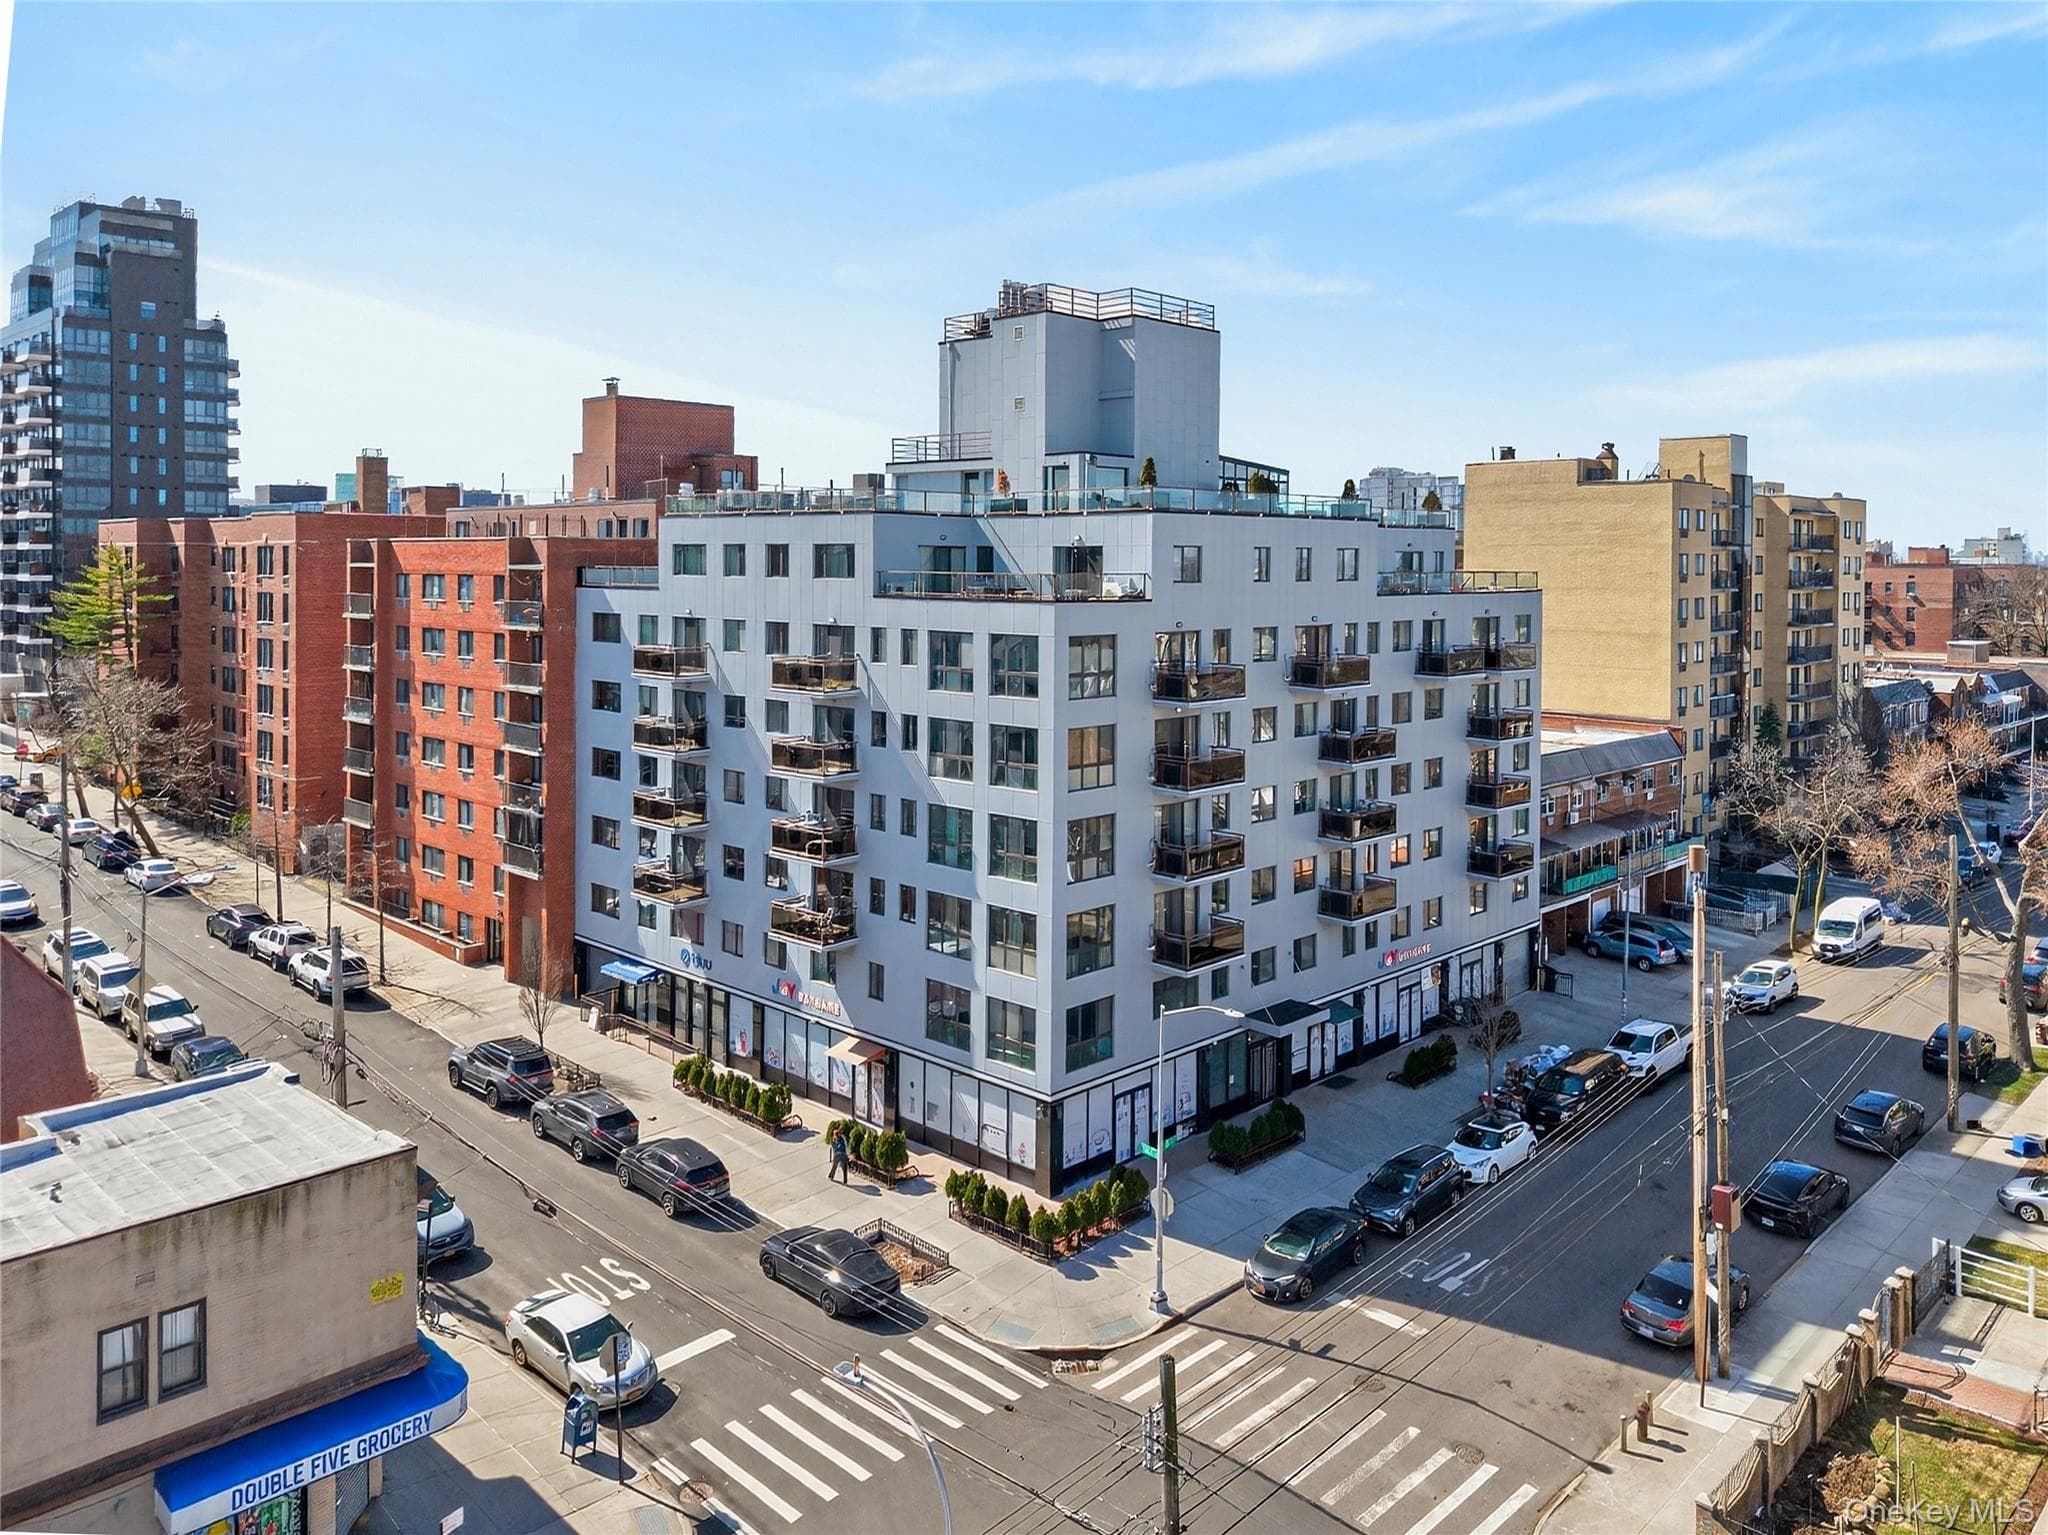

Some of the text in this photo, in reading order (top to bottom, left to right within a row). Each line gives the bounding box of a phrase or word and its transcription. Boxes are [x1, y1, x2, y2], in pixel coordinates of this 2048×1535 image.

[546, 1258, 651, 1307] STO
[231, 1411, 433, 1511] DOUBLE FIVE GROCERY
